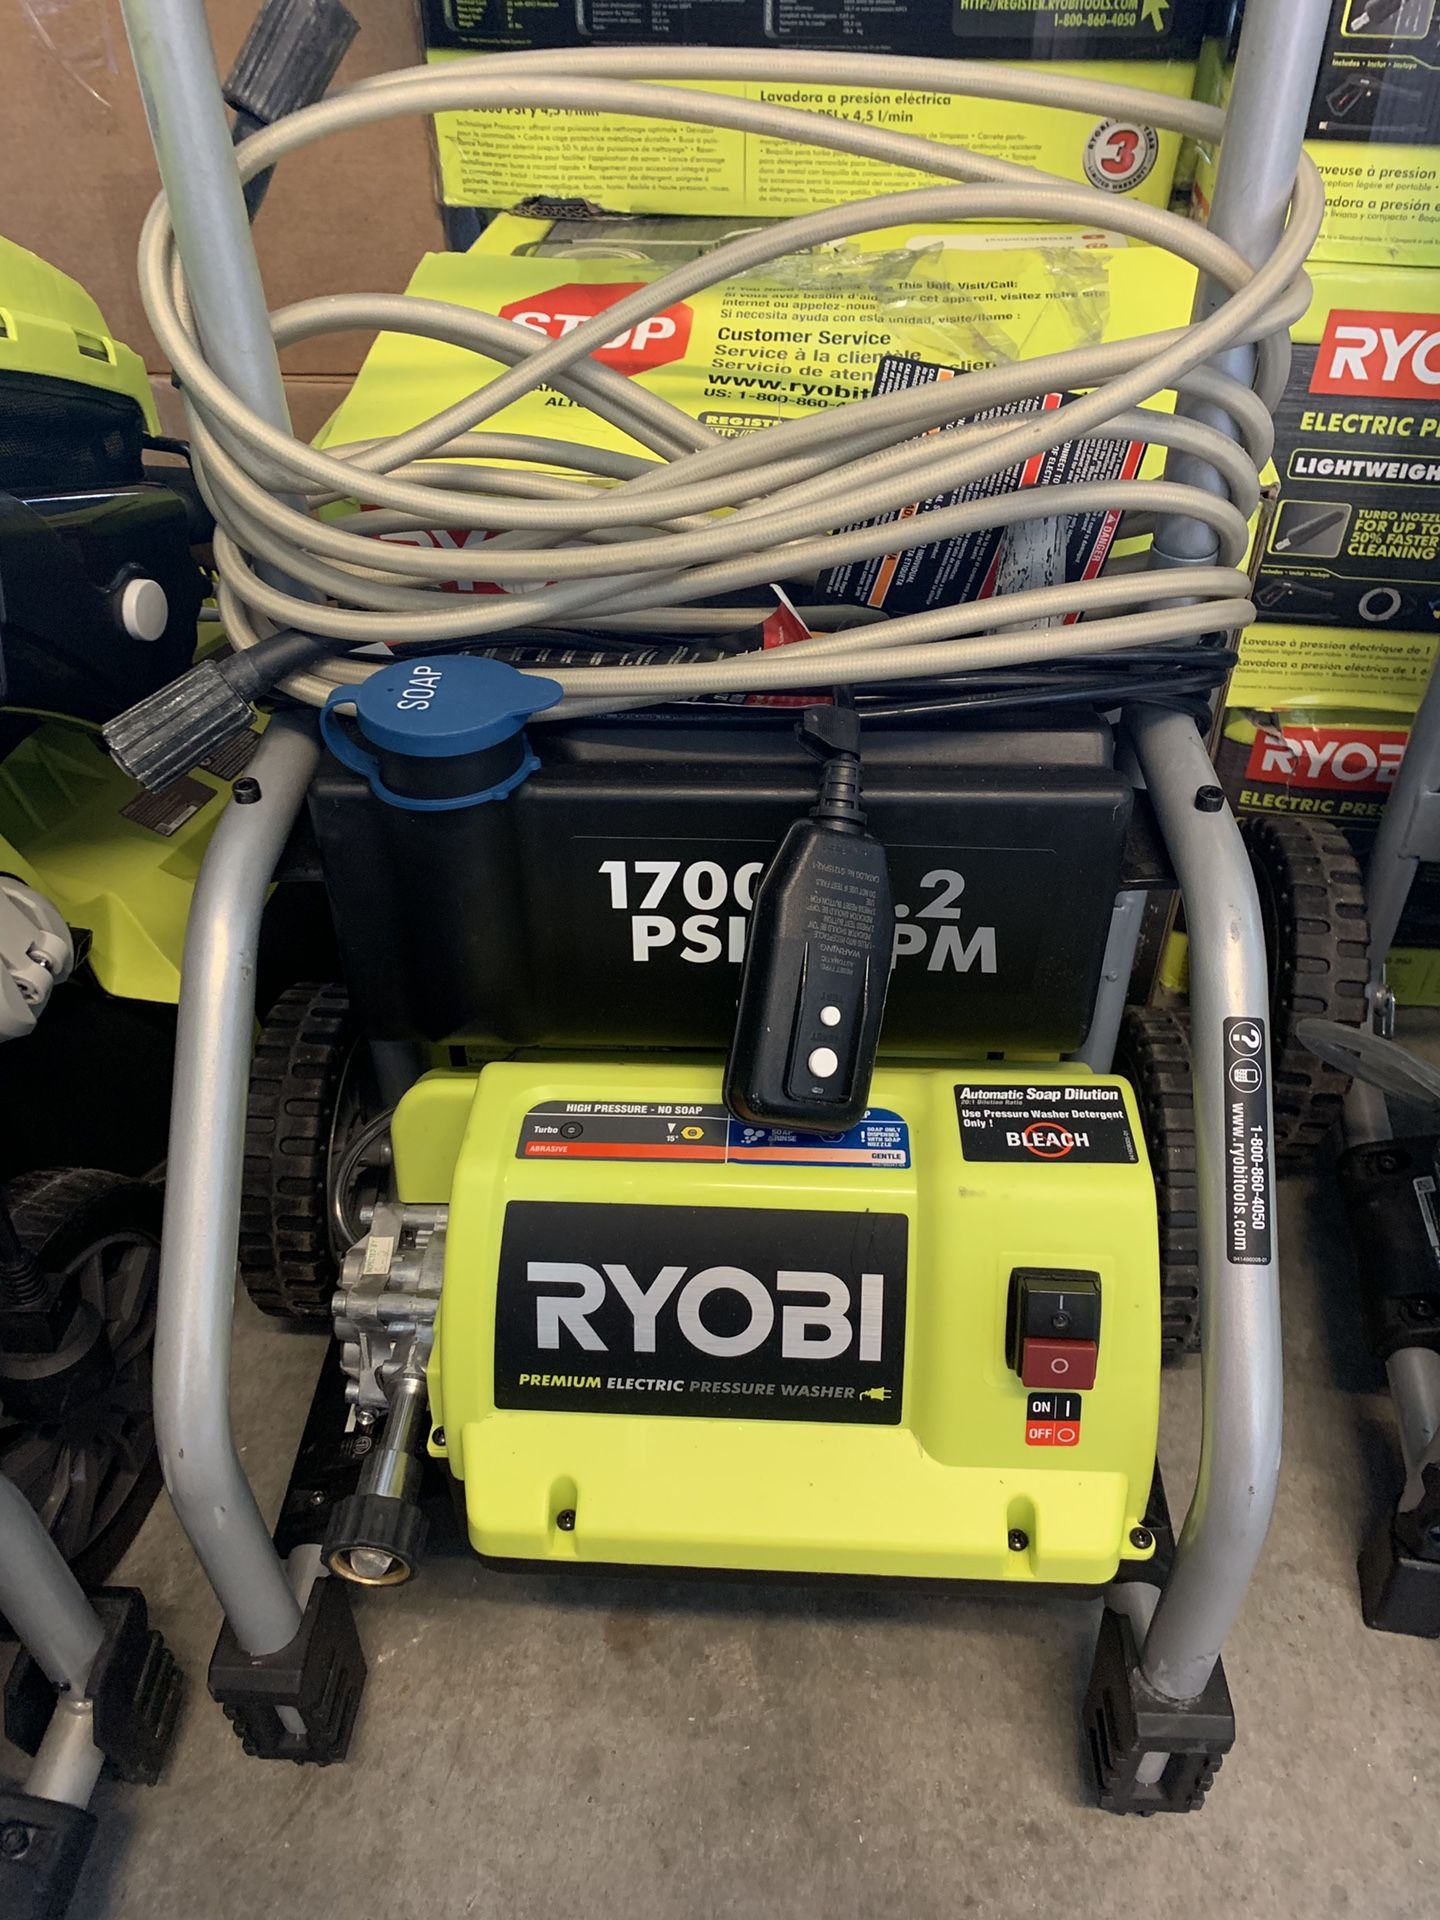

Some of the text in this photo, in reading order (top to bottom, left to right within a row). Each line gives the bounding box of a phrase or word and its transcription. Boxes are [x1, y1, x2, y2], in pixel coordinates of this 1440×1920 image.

[1054, 12, 1136, 27] 1-800-860-4050
[760, 90, 951, 106] Lavadora a presión eléctrica
[854, 110, 874, 122] 4,5
[878, 110, 913, 122] l/min
[1101, 130, 1139, 174] 3
[1317, 166, 1362, 176] aveuse
[1379, 166, 1436, 180] pression
[1325, 195, 1363, 207] adora
[1380, 199, 1430, 211] presión
[958, 281, 1018, 289] Visit/Call:
[721, 309, 731, 318] Si
[736, 310, 787, 320] necesita
[792, 314, 828, 322] ayuda
[833, 314, 855, 322] con
[718, 327, 891, 345] Customer Service
[715, 345, 831, 363] Service à la
[1329, 326, 1440, 384] RYO
[712, 359, 873, 381] Servicio de aten
[704, 388, 731, 399] US:
[708, 374, 871, 399] www.ryobit
[1301, 411, 1415, 436] ELECTRIC
[1042, 457, 1056, 485] ELECTR
[1295, 457, 1440, 480] LIGHTWEIGH
[1359, 509, 1440, 522] TURBO NOZZL
[1355, 519, 1440, 535] FOR UP TO
[1092, 525, 1112, 562] DANGER
[1351, 531, 1439, 547] 50% FASTER
[1348, 543, 1436, 560] CLEANING
[1243, 636, 1287, 647] Laveuse
[1300, 640, 1346, 651] pression
[1349, 642, 1403, 655] électrique
[1407, 645, 1421, 655] de
[1237, 657, 1287, 668] Lavadora
[1301, 660, 1341, 672] presión
[1392, 666, 1406, 674] de
[396, 665, 443, 710] SOAP
[1262, 735, 1405, 783] RYOB
[1239, 790, 1335, 813] ELECTRIC
[598, 860, 965, 919] 1700 .2
[631, 915, 998, 974] PSI PM
[820, 943, 861, 958] WARNING
[960, 1087, 1119, 1102] Automatic Soap Dilution
[566, 1104, 591, 1113] HIGH
[594, 1104, 647, 1114] PRESSURE
[657, 1106, 672, 1114] NO
[674, 1106, 703, 1115] SOAP
[962, 1109, 1123, 1120] Use Pressure Washer Detergent
[534, 1126, 558, 1134] Turbo
[963, 1119, 986, 1129] Only
[1006, 1132, 1090, 1147] BLEACH
[529, 1145, 568, 1153] ABRASIVE
[1230, 1102, 1249, 1250] www.ryobitools.com
[1250, 1125, 1265, 1230] 1-800-860-4050
[526, 1262, 884, 1362] RYOBI
[519, 1373, 855, 1399] PREMIUM ELECTRIC PRESSURE WASHER
[1032, 1401, 1050, 1413] ON
[1029, 1428, 1052, 1439] OFF
